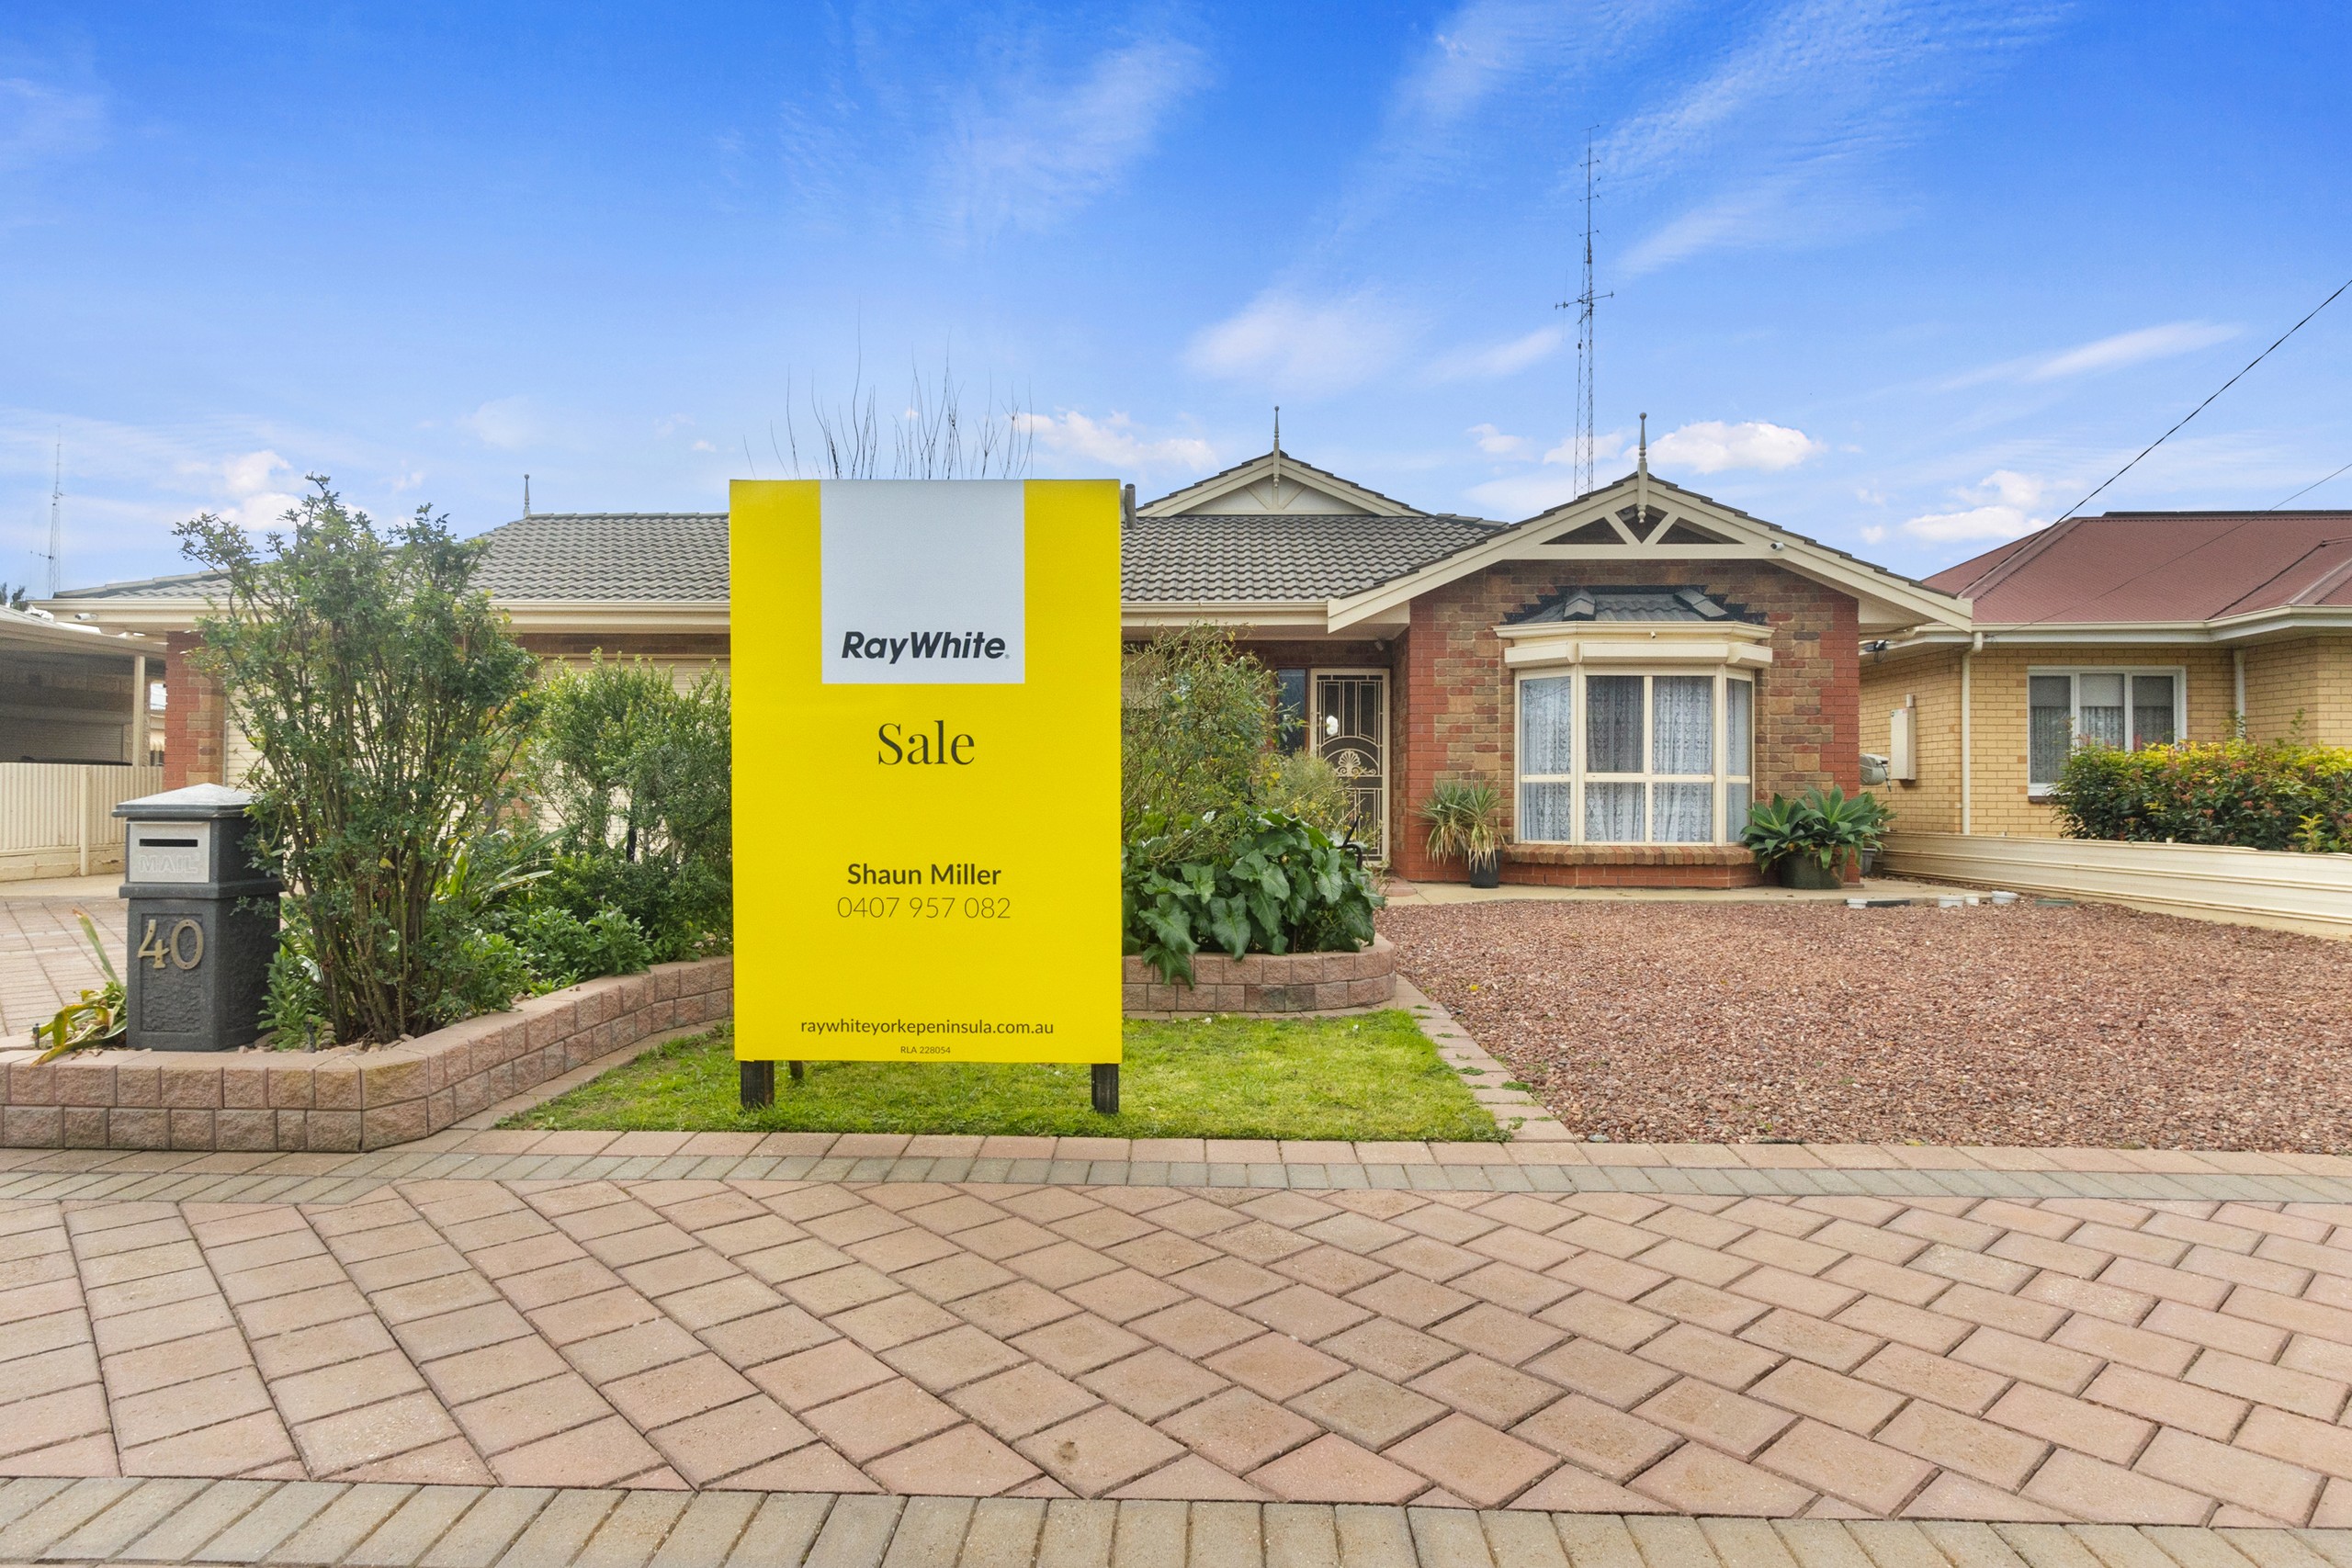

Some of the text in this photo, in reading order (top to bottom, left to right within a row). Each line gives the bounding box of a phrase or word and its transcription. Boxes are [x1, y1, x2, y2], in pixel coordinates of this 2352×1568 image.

[877, 719, 976, 766] Sale
[139, 855, 198, 874] MAIL
[847, 863, 1001, 885] Shaun Miller
[837, 897, 1011, 919] 0407 957 082
[138, 919, 204, 970] 40
[800, 1018, 1054, 1036] raywhiteyorkepeninsula.com.au
[900, 1045, 951, 1055] RLA 228054
